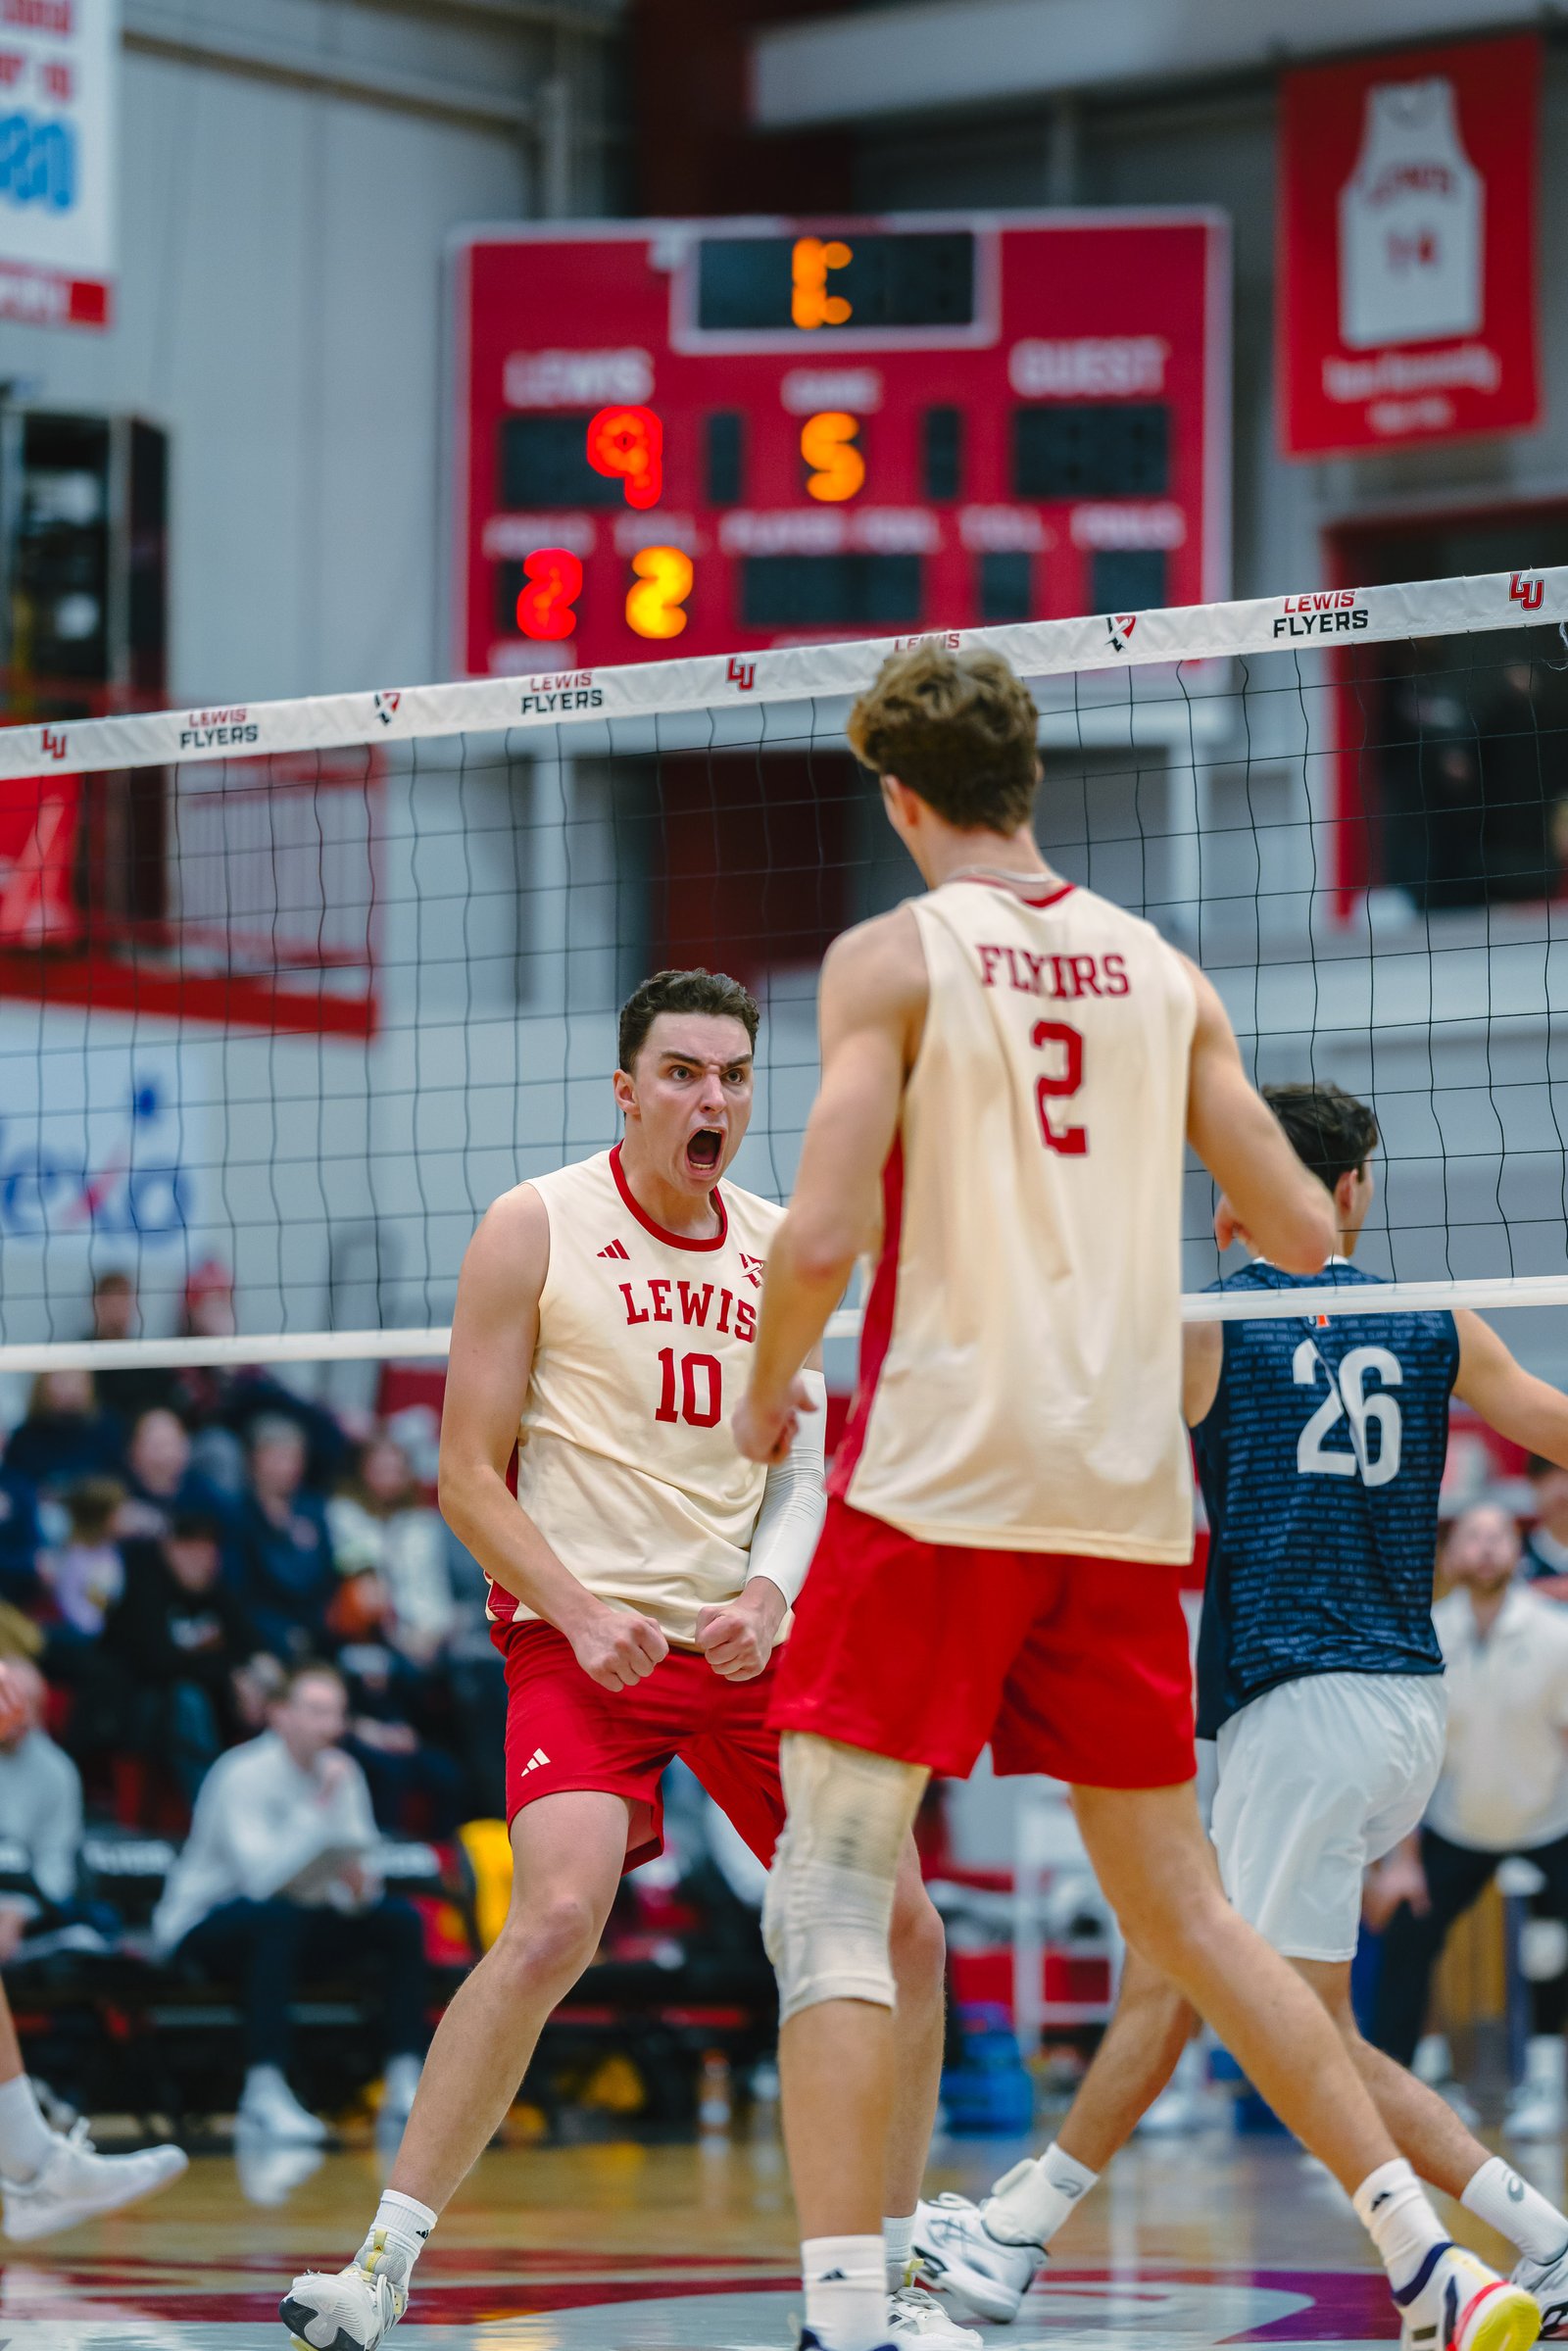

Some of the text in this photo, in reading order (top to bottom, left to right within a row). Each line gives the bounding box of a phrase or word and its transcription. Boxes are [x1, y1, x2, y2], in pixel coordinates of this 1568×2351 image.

[587, 405, 663, 511] 9
[801, 412, 866, 503] 5
[625, 545, 694, 640] 2
[1284, 590, 1357, 614] LEWIS
[1508, 571, 1545, 612] LU
[1273, 610, 1370, 638] FLYERS
[530, 671, 594, 693] LEWIS
[725, 657, 757, 692] LU
[188, 708, 248, 728] LEWIS
[520, 688, 604, 715] FLYERS
[41, 728, 67, 760] LU
[179, 723, 260, 750] FLYERS
[1032, 1019, 1091, 1157] 2
[617, 1278, 758, 1345] LEWIS
[655, 1347, 722, 1429] 10
[1293, 1338, 1403, 1488] 26
